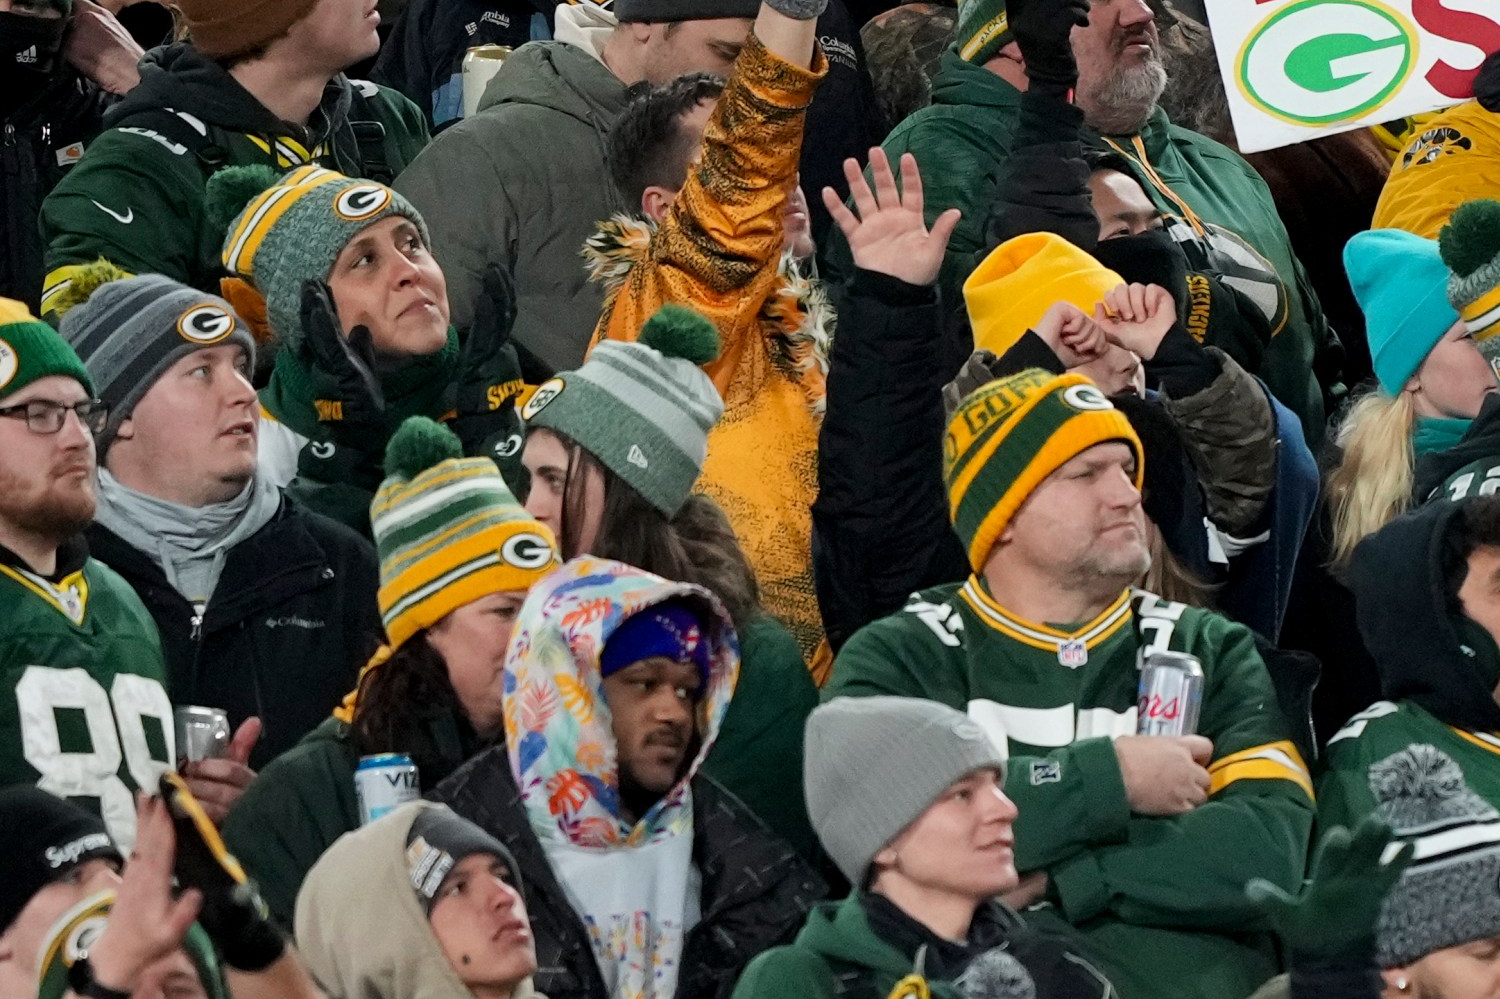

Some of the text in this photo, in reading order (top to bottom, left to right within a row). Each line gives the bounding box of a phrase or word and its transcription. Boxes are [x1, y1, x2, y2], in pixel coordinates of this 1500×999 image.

[337, 185, 388, 217] G
[181, 308, 231, 341] G
[1064, 384, 1114, 410] G
[501, 533, 553, 569] G
